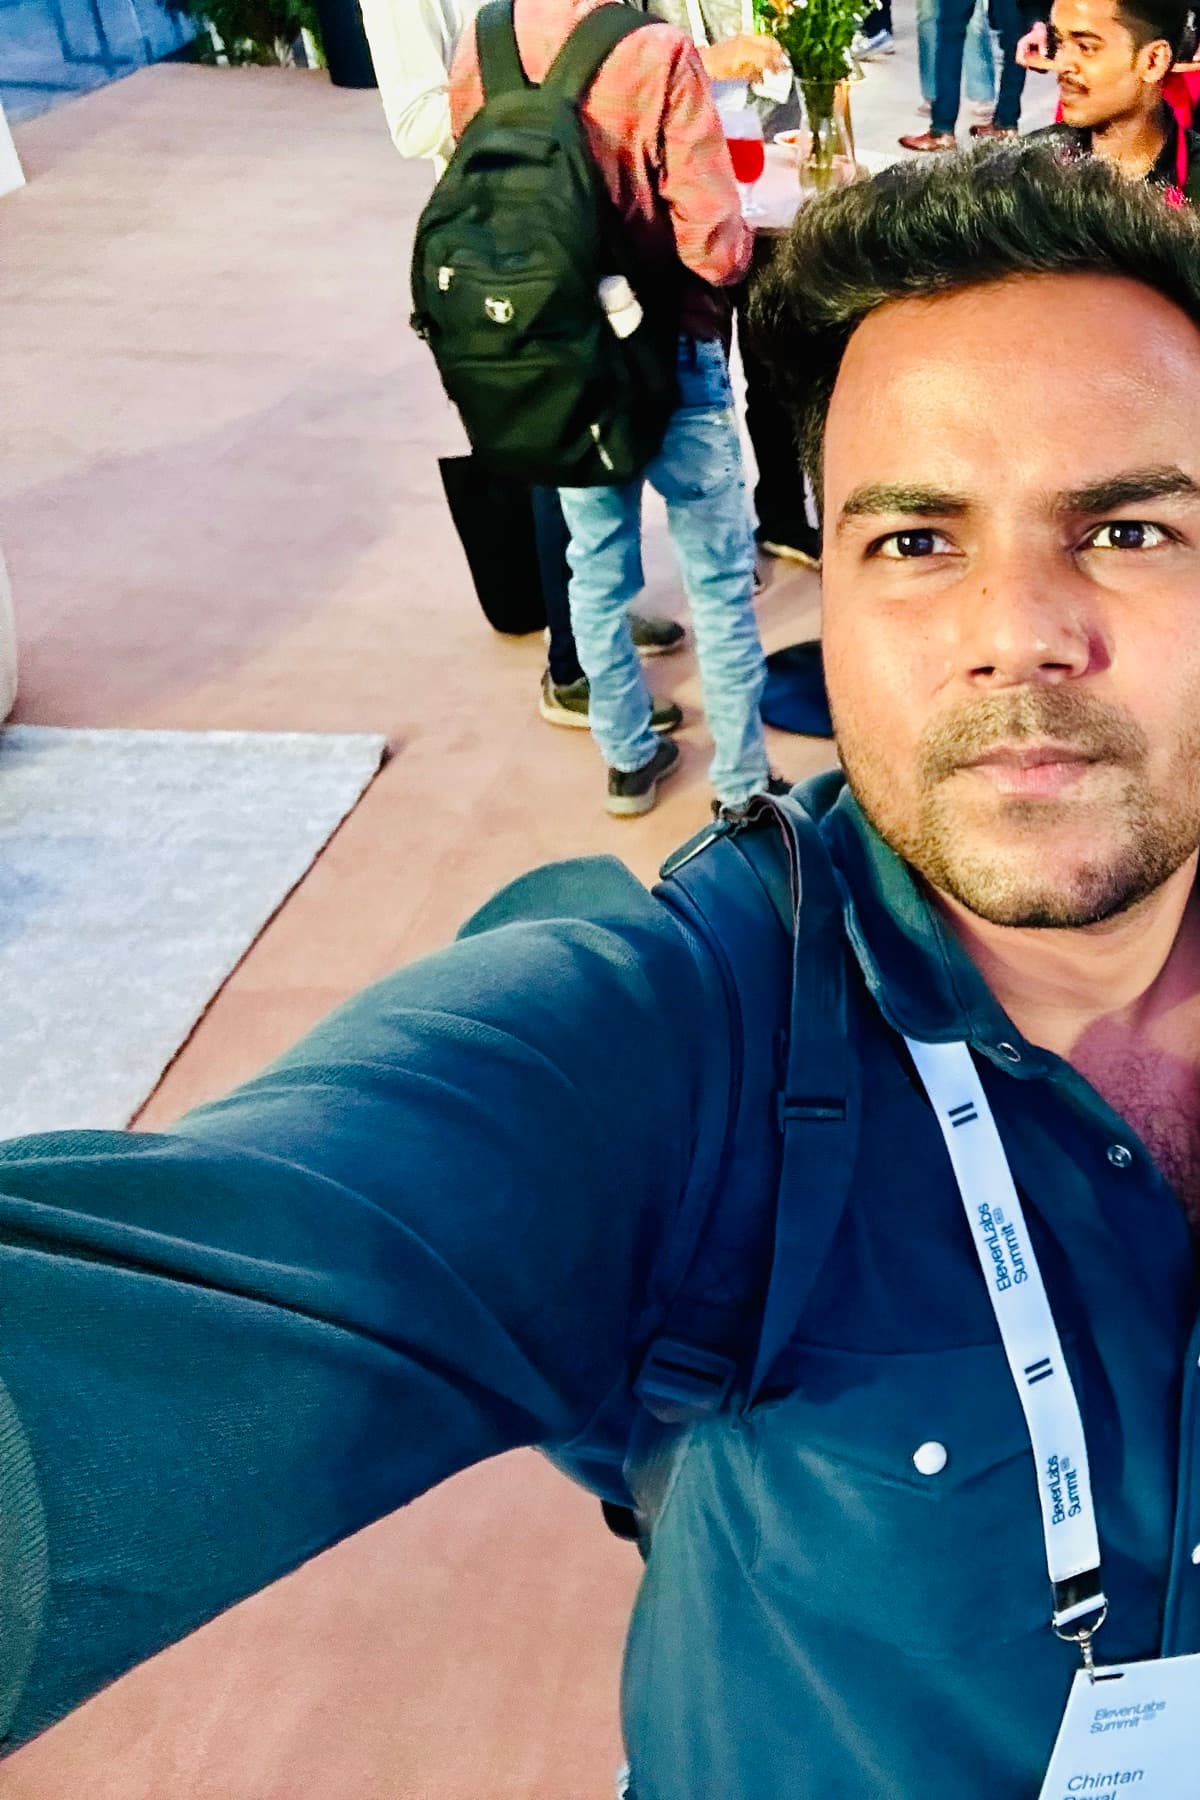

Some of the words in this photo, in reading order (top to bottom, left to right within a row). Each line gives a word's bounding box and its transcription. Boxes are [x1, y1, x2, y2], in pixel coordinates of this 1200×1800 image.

[978, 1202, 1012, 1292] ElevenLabs
[1001, 1223, 1028, 1284] Summit
[1047, 1455, 1066, 1525] ElevenLabs
[1064, 1468, 1082, 1518] Summit
[1067, 1769, 1144, 1791] Chintan
